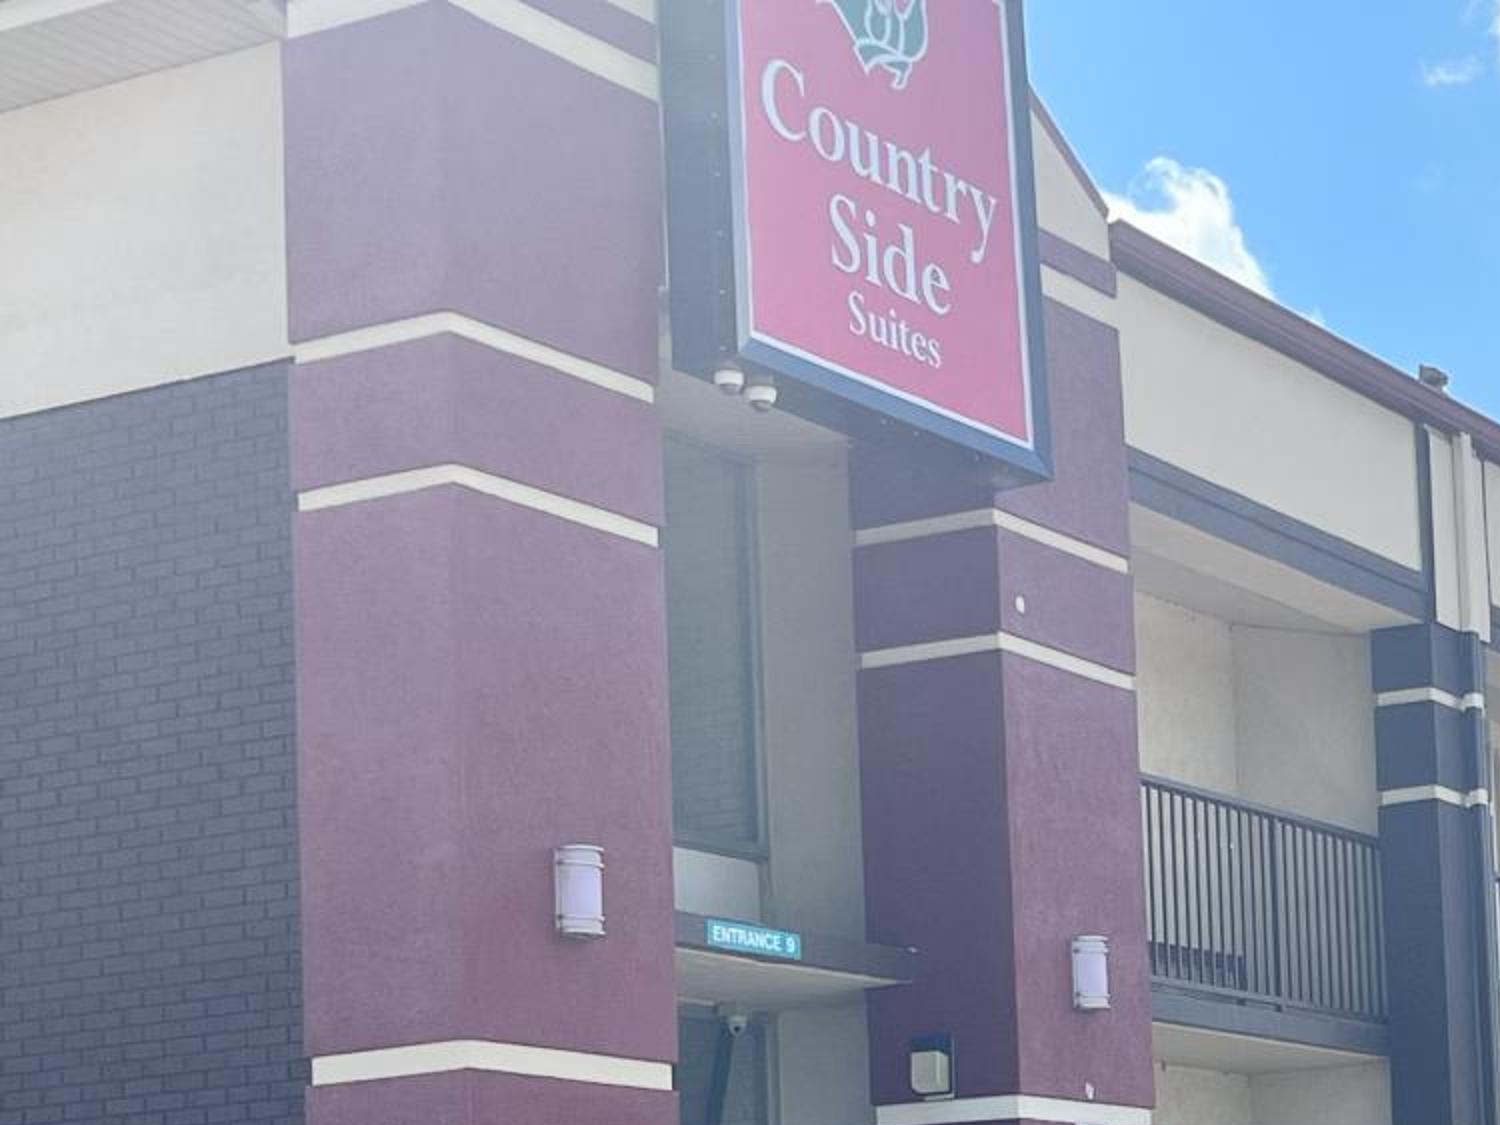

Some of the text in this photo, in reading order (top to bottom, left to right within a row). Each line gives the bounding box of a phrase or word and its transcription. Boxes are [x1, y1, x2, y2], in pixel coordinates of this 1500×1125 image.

[761, 58, 997, 264] Country
[829, 193, 952, 316] Side
[848, 290, 942, 369] Suites
[712, 924, 796, 954] ENTRANCE 9
